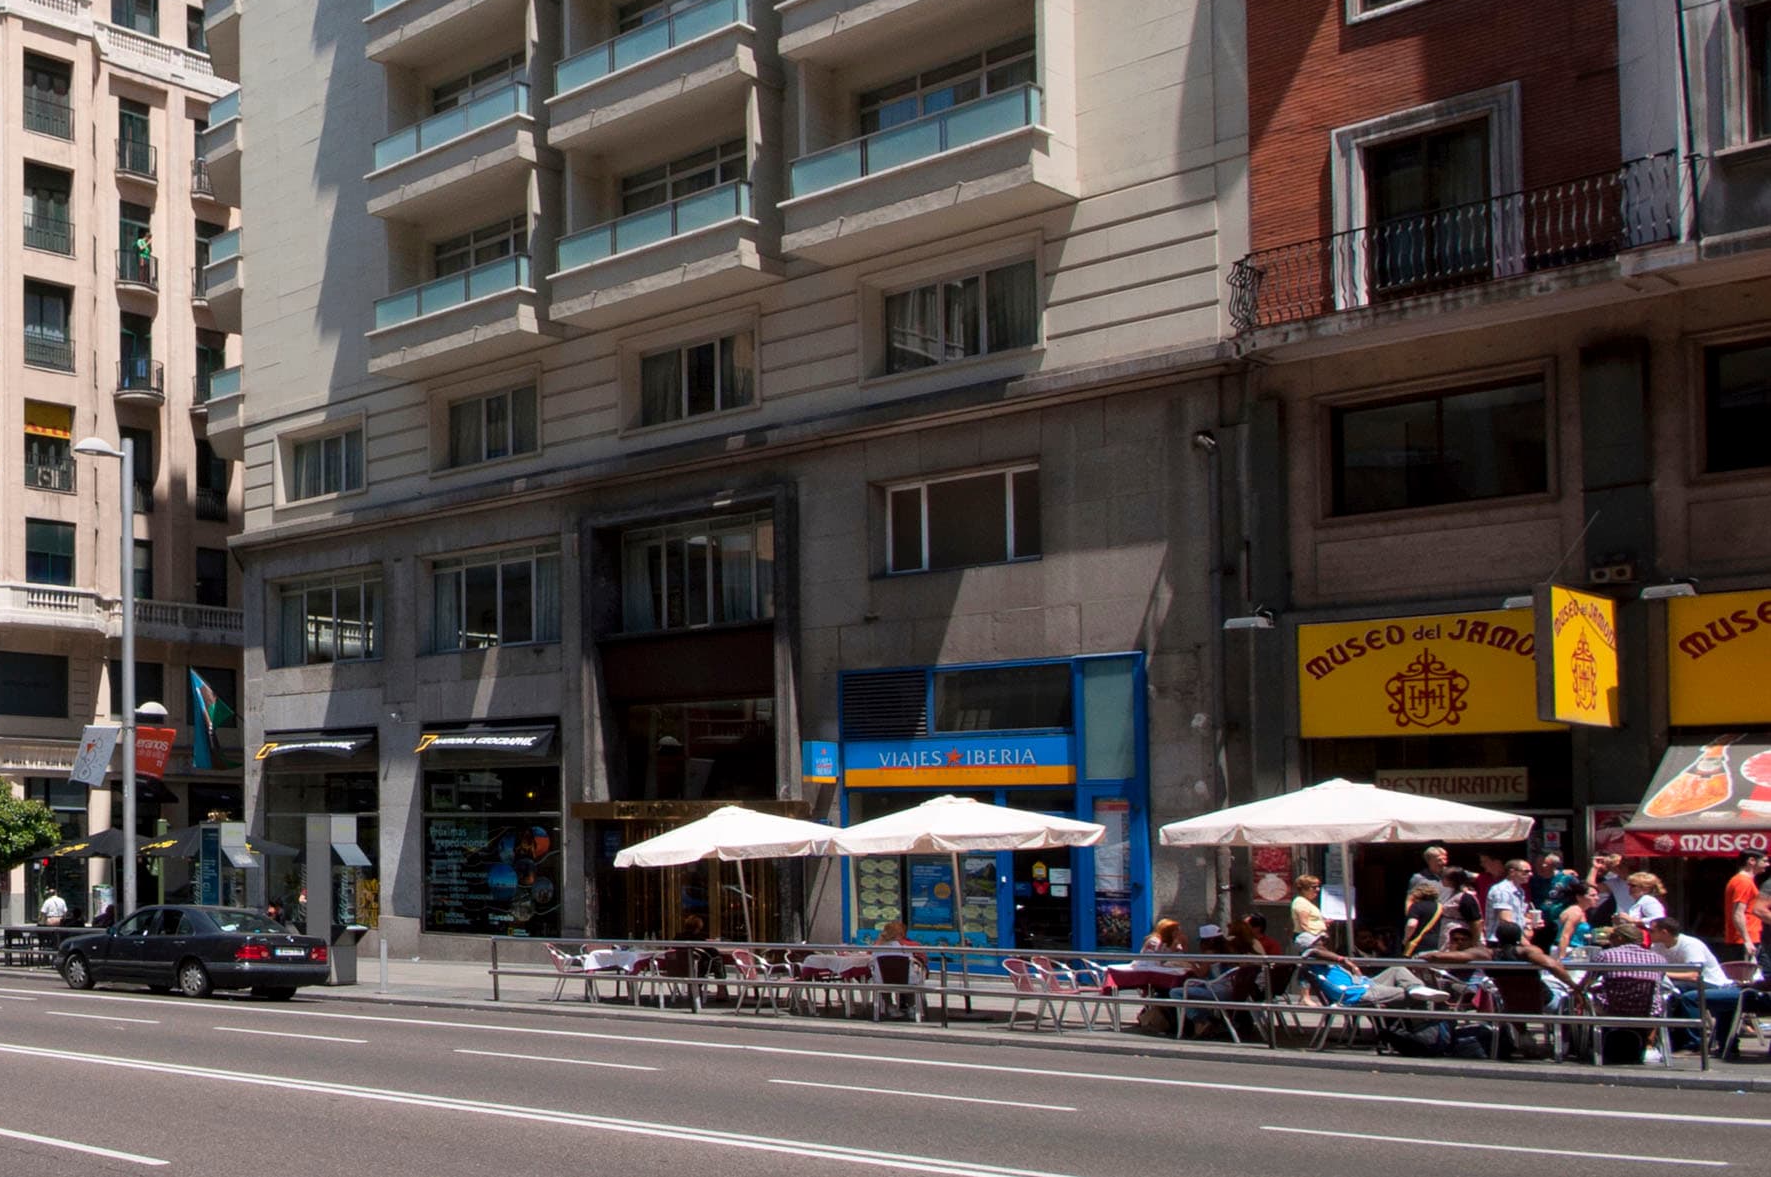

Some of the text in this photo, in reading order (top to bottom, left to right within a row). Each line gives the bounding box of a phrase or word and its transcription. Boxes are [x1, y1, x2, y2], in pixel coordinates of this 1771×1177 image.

[1305, 619, 1536, 681] MUSEO del JAMO
[136, 739, 168, 751] eranos
[476, 736, 536, 746] GEOGRAPHIC
[879, 749, 1036, 769] VIAJES IBERIA
[1679, 834, 1768, 854] MUSEO
